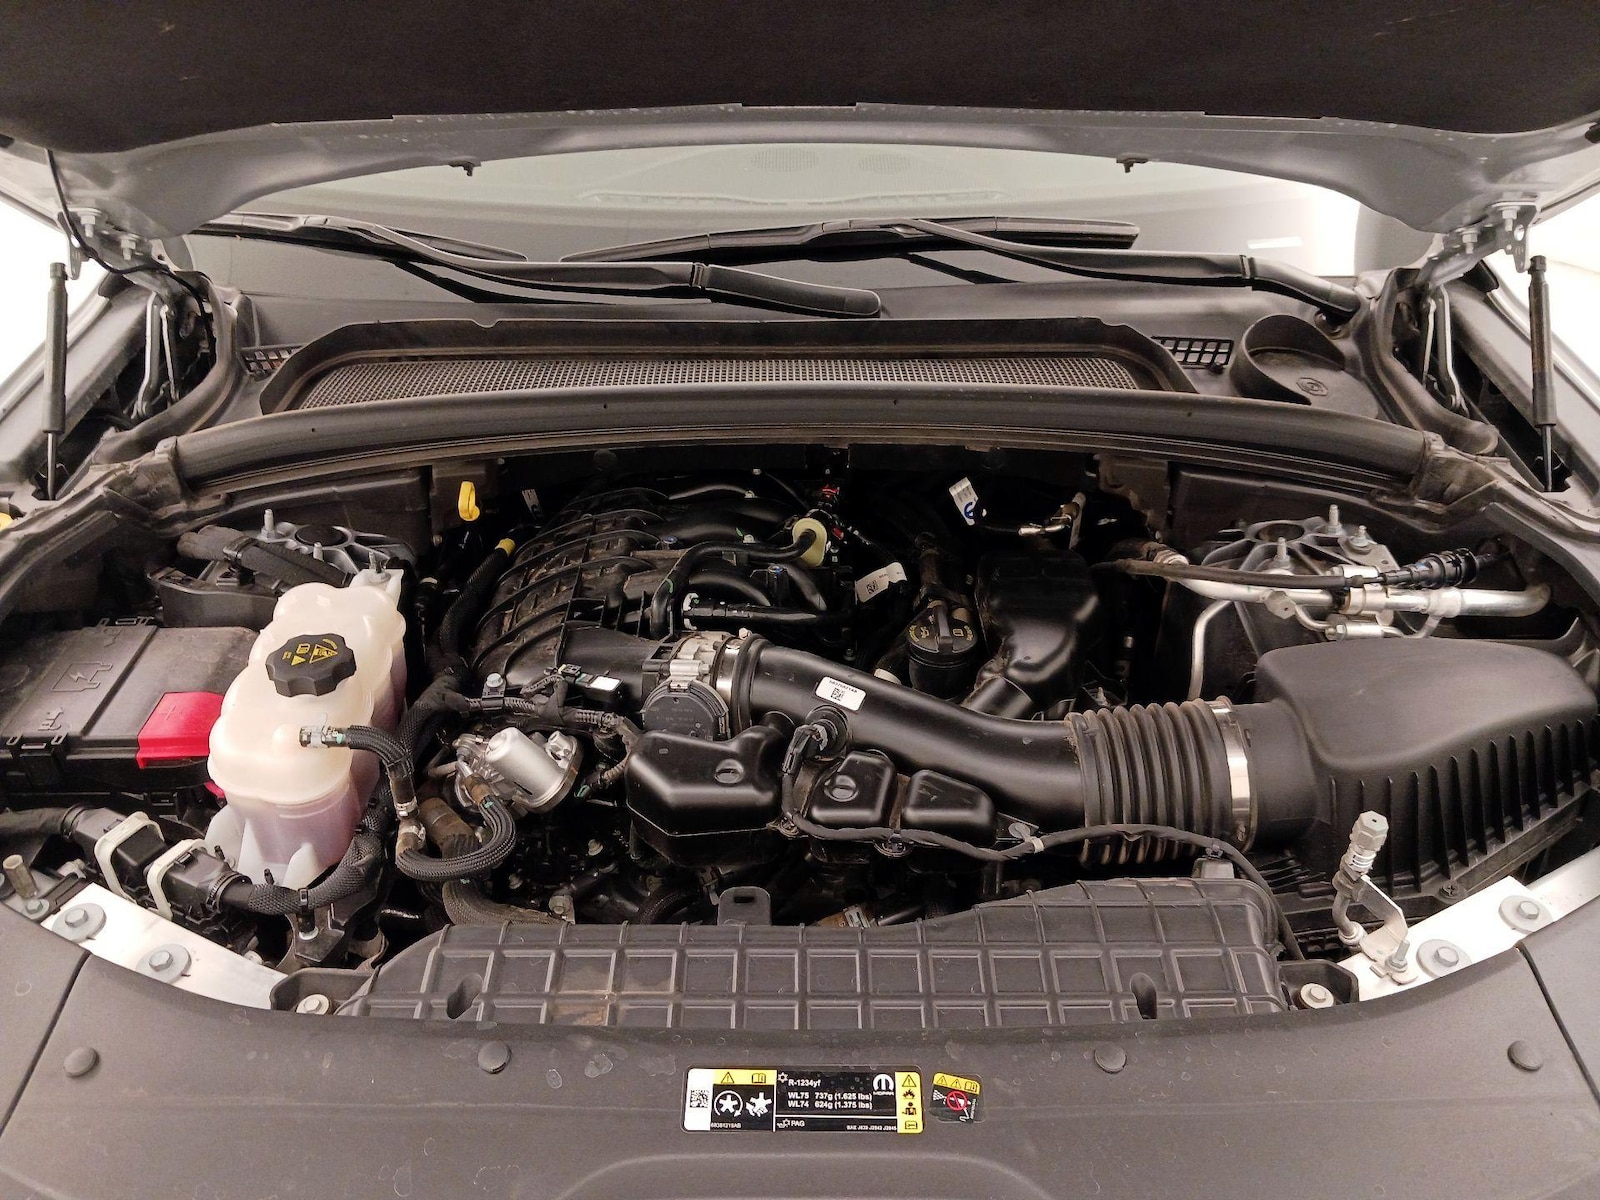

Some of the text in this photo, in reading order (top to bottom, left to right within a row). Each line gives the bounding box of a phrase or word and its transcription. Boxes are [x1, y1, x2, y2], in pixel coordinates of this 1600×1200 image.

[788, 1079, 821, 1088] R-1234yf
[788, 1092, 873, 1101] WL75 737g (1.625 lbs)
[788, 1100, 873, 1110] WL74 624g (1.375 lbs)
